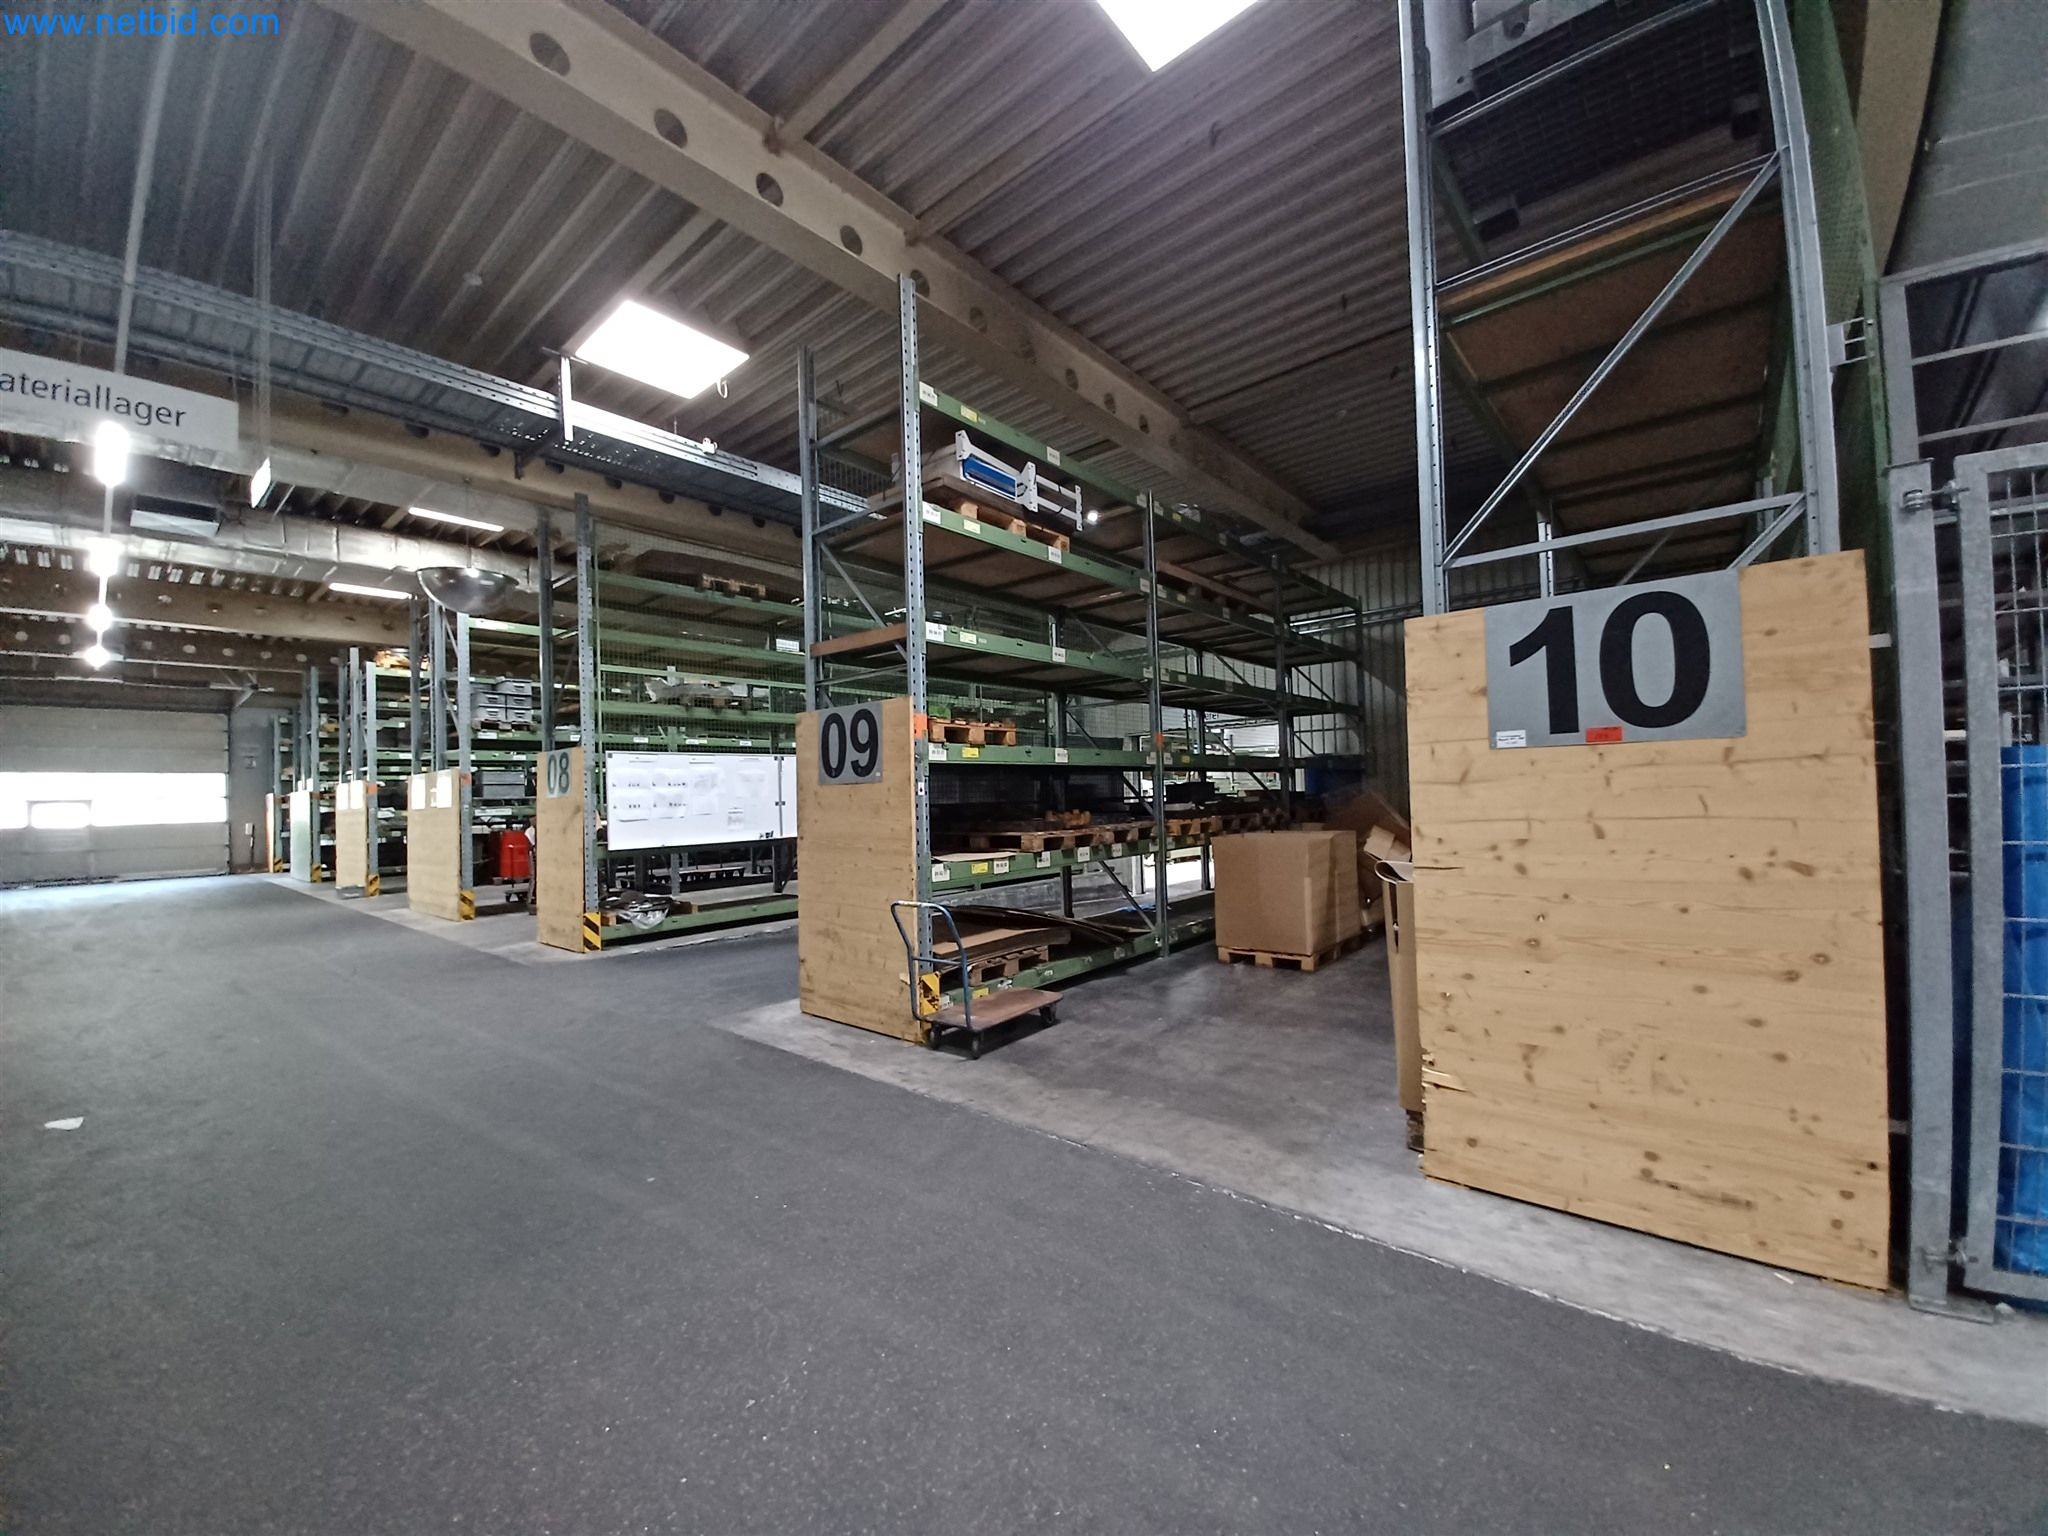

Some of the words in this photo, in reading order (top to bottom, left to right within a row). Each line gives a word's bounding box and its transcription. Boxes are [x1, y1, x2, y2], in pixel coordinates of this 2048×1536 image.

[0, 372, 187, 427] ateriallager
[1509, 590, 1711, 735] 10
[547, 751, 570, 795] 08
[821, 708, 879, 779] 09
